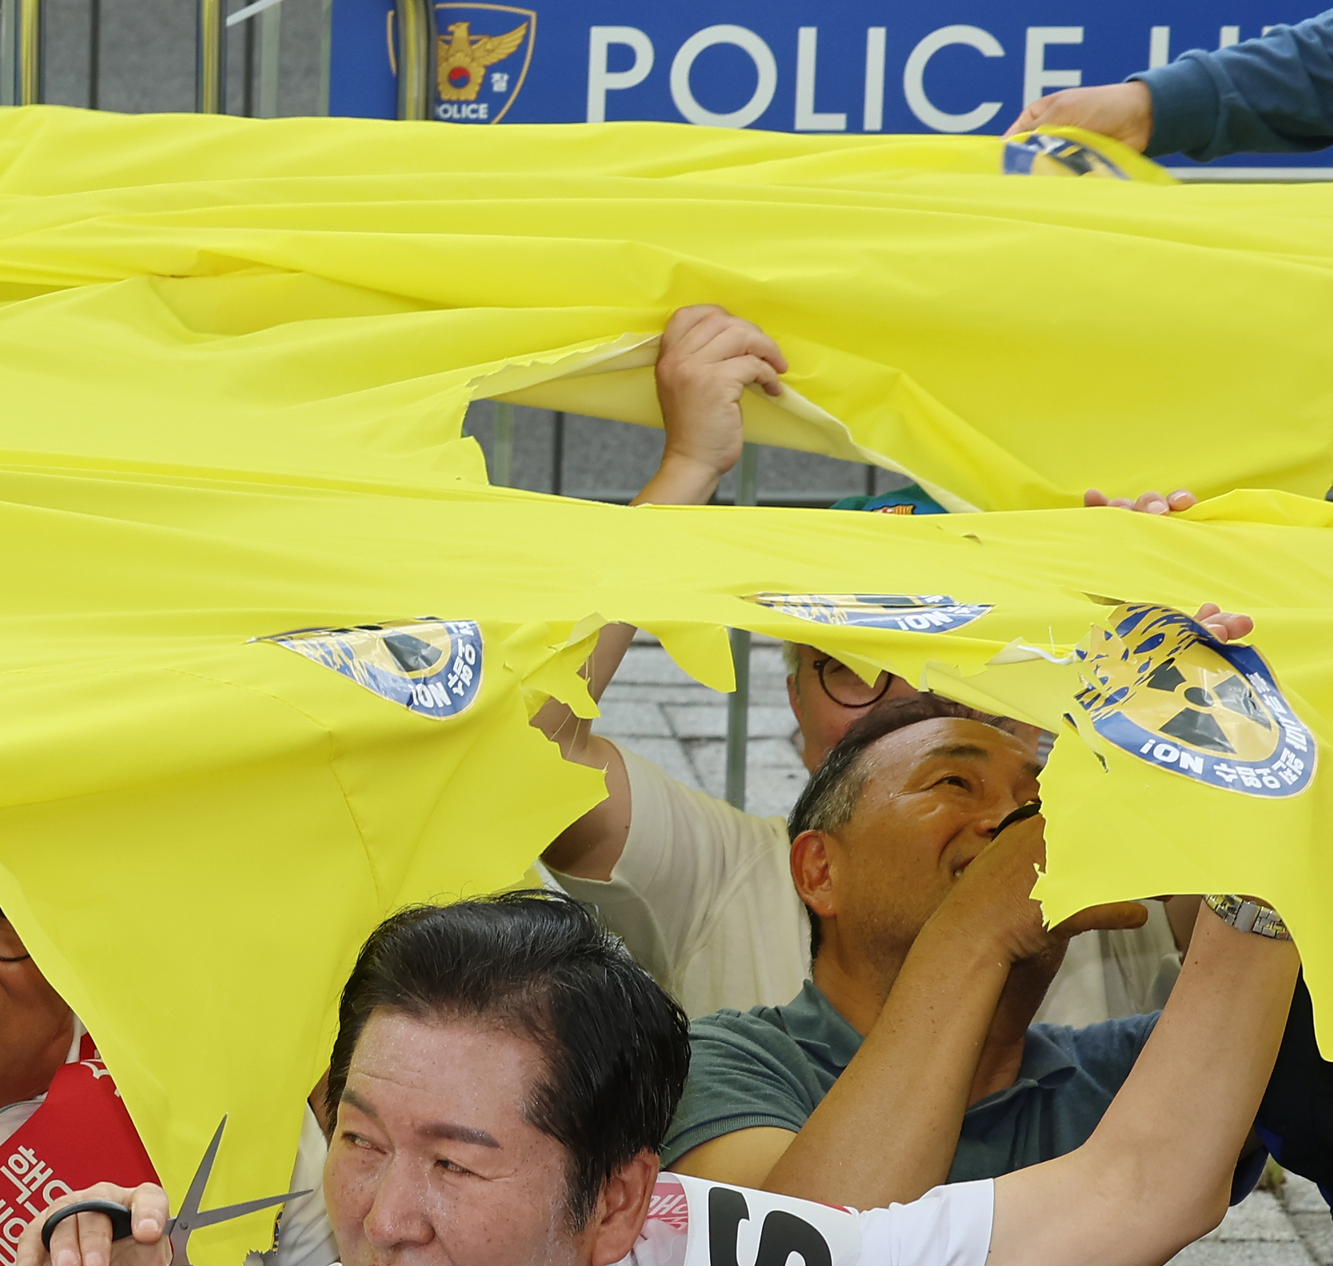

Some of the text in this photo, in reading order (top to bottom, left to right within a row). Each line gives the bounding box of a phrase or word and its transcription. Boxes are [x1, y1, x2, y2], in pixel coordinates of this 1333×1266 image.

[586, 23, 1084, 133] POLICE
[436, 103, 489, 119] OLICE
[894, 609, 954, 632] NO!
[447, 638, 477, 697] 오염수
[408, 681, 452, 711] NO!
[1138, 738, 1205, 775] NO!
[1271, 747, 1305, 786] 원전
[1213, 762, 1281, 790] 오염수
